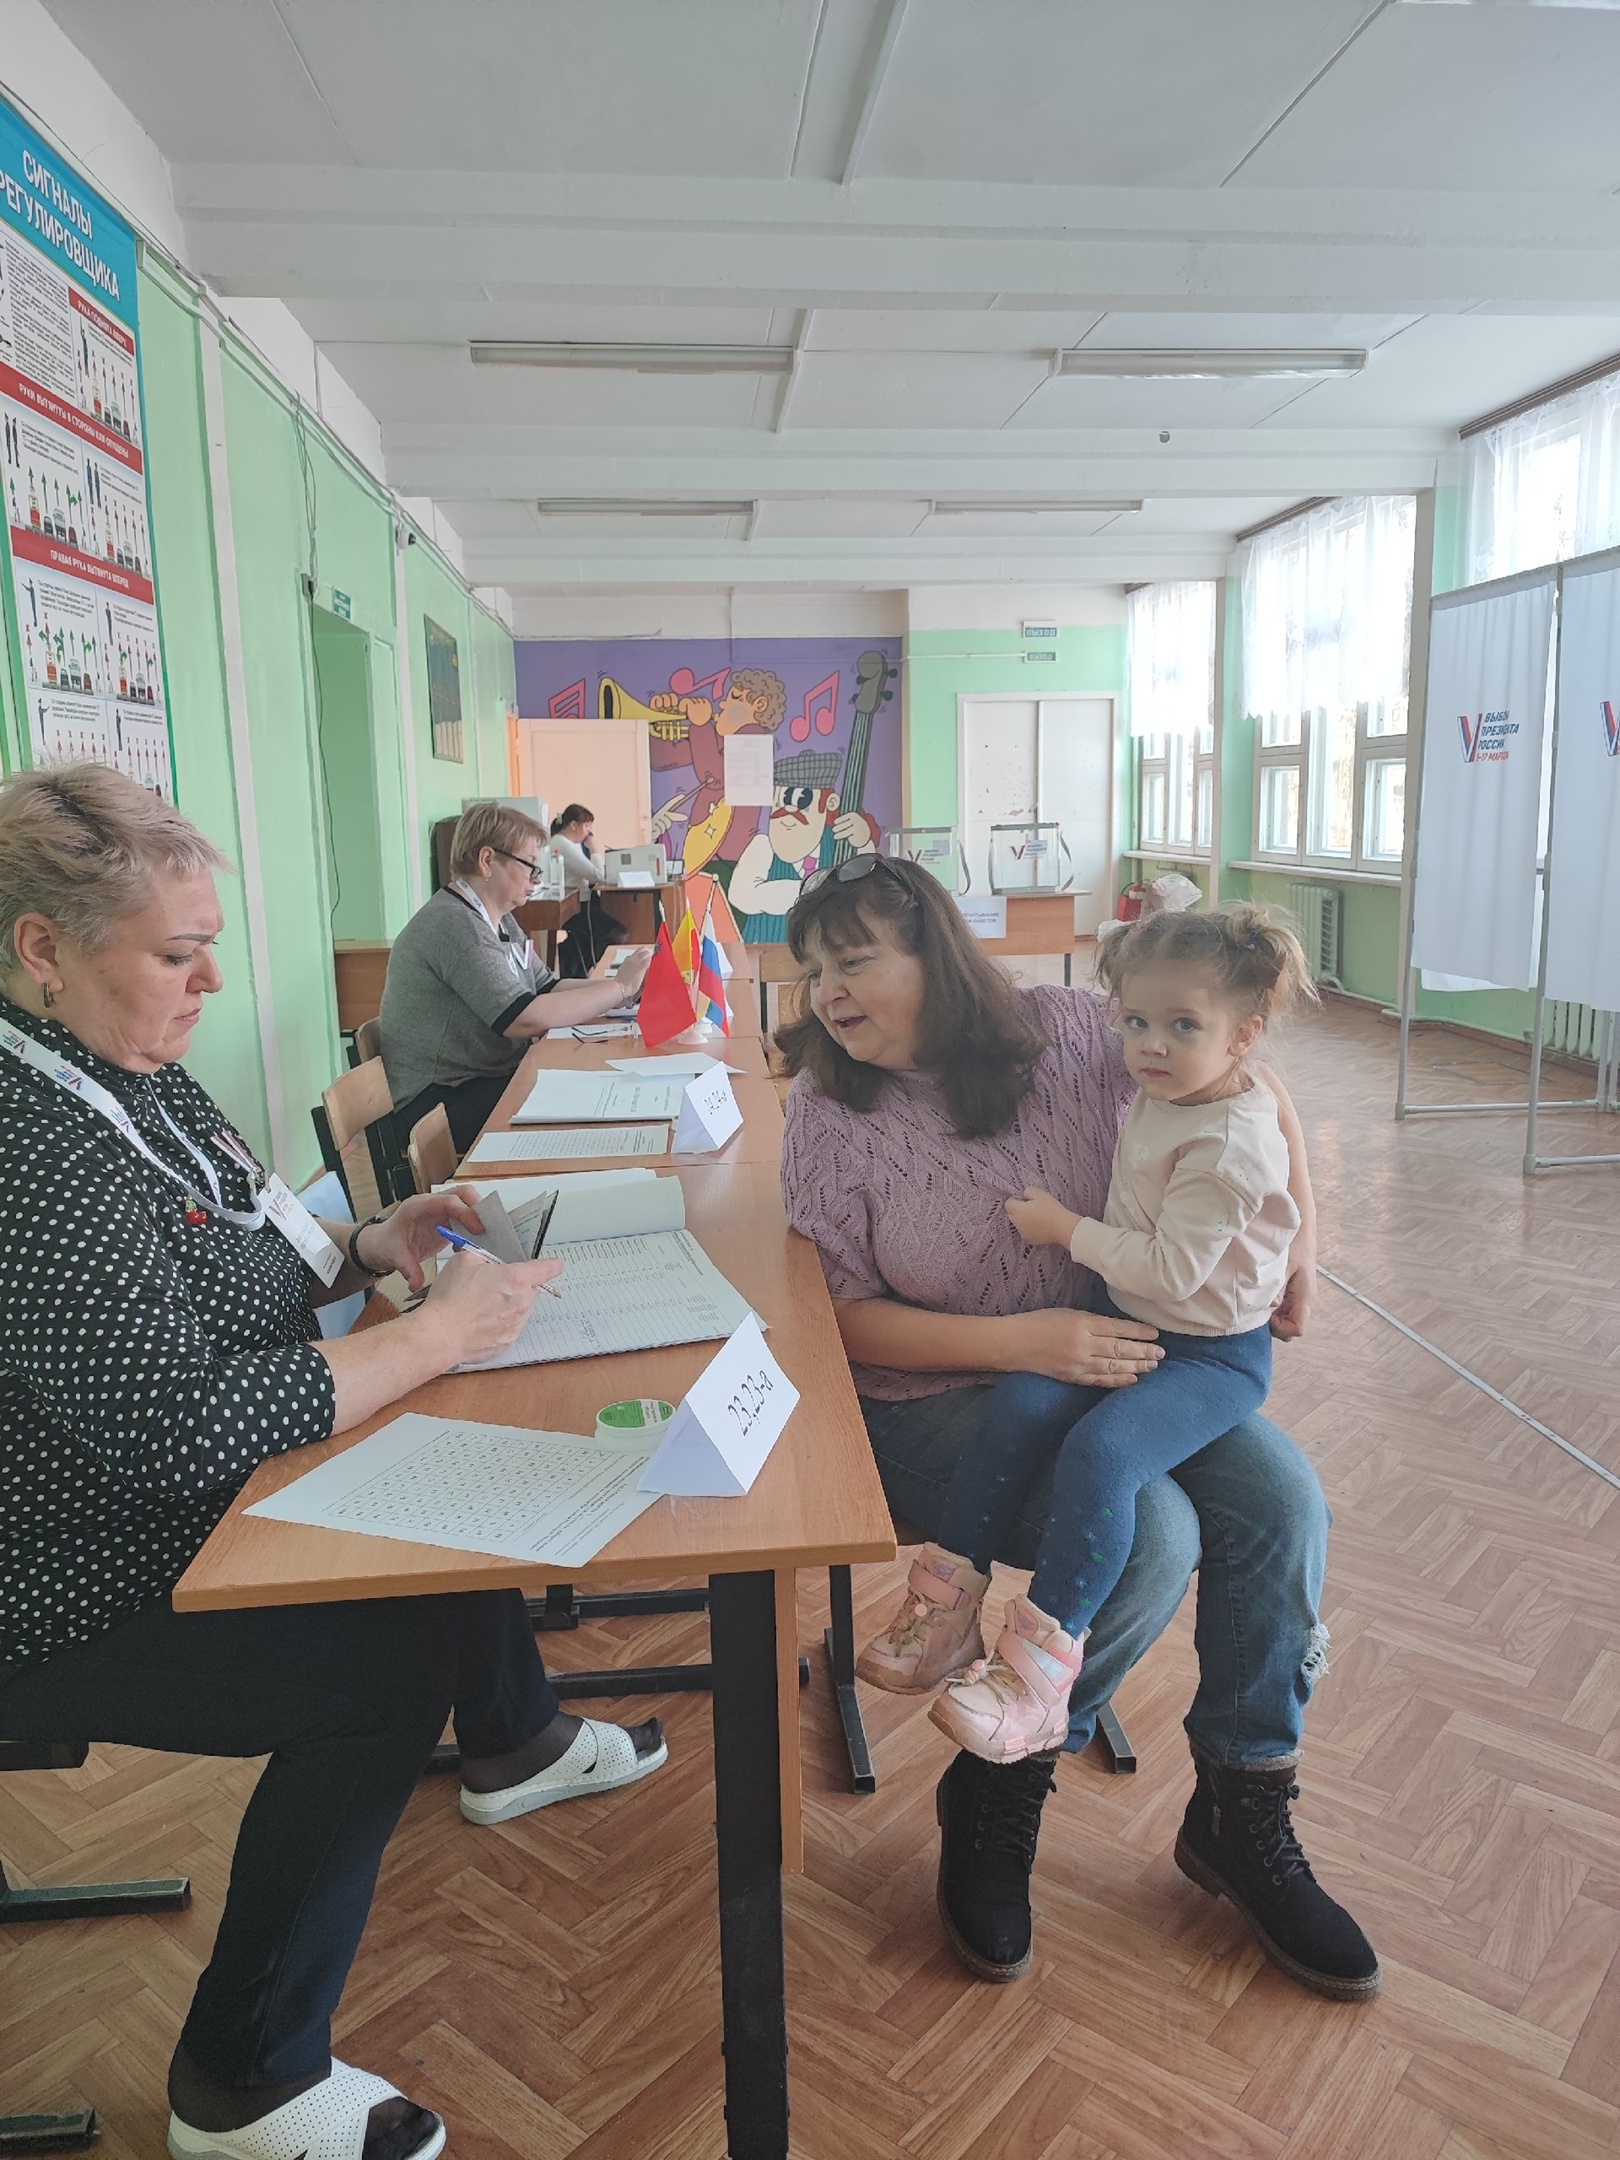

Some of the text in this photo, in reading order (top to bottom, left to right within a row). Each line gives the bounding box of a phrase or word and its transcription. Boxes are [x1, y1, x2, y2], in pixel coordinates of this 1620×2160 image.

[23, 150, 93, 239] СИГНАЛЫ
[19, 383, 36, 401] РУКИ
[50, 550, 72, 566] ПРАВАЯ
[72, 558, 86, 571] РУКА
